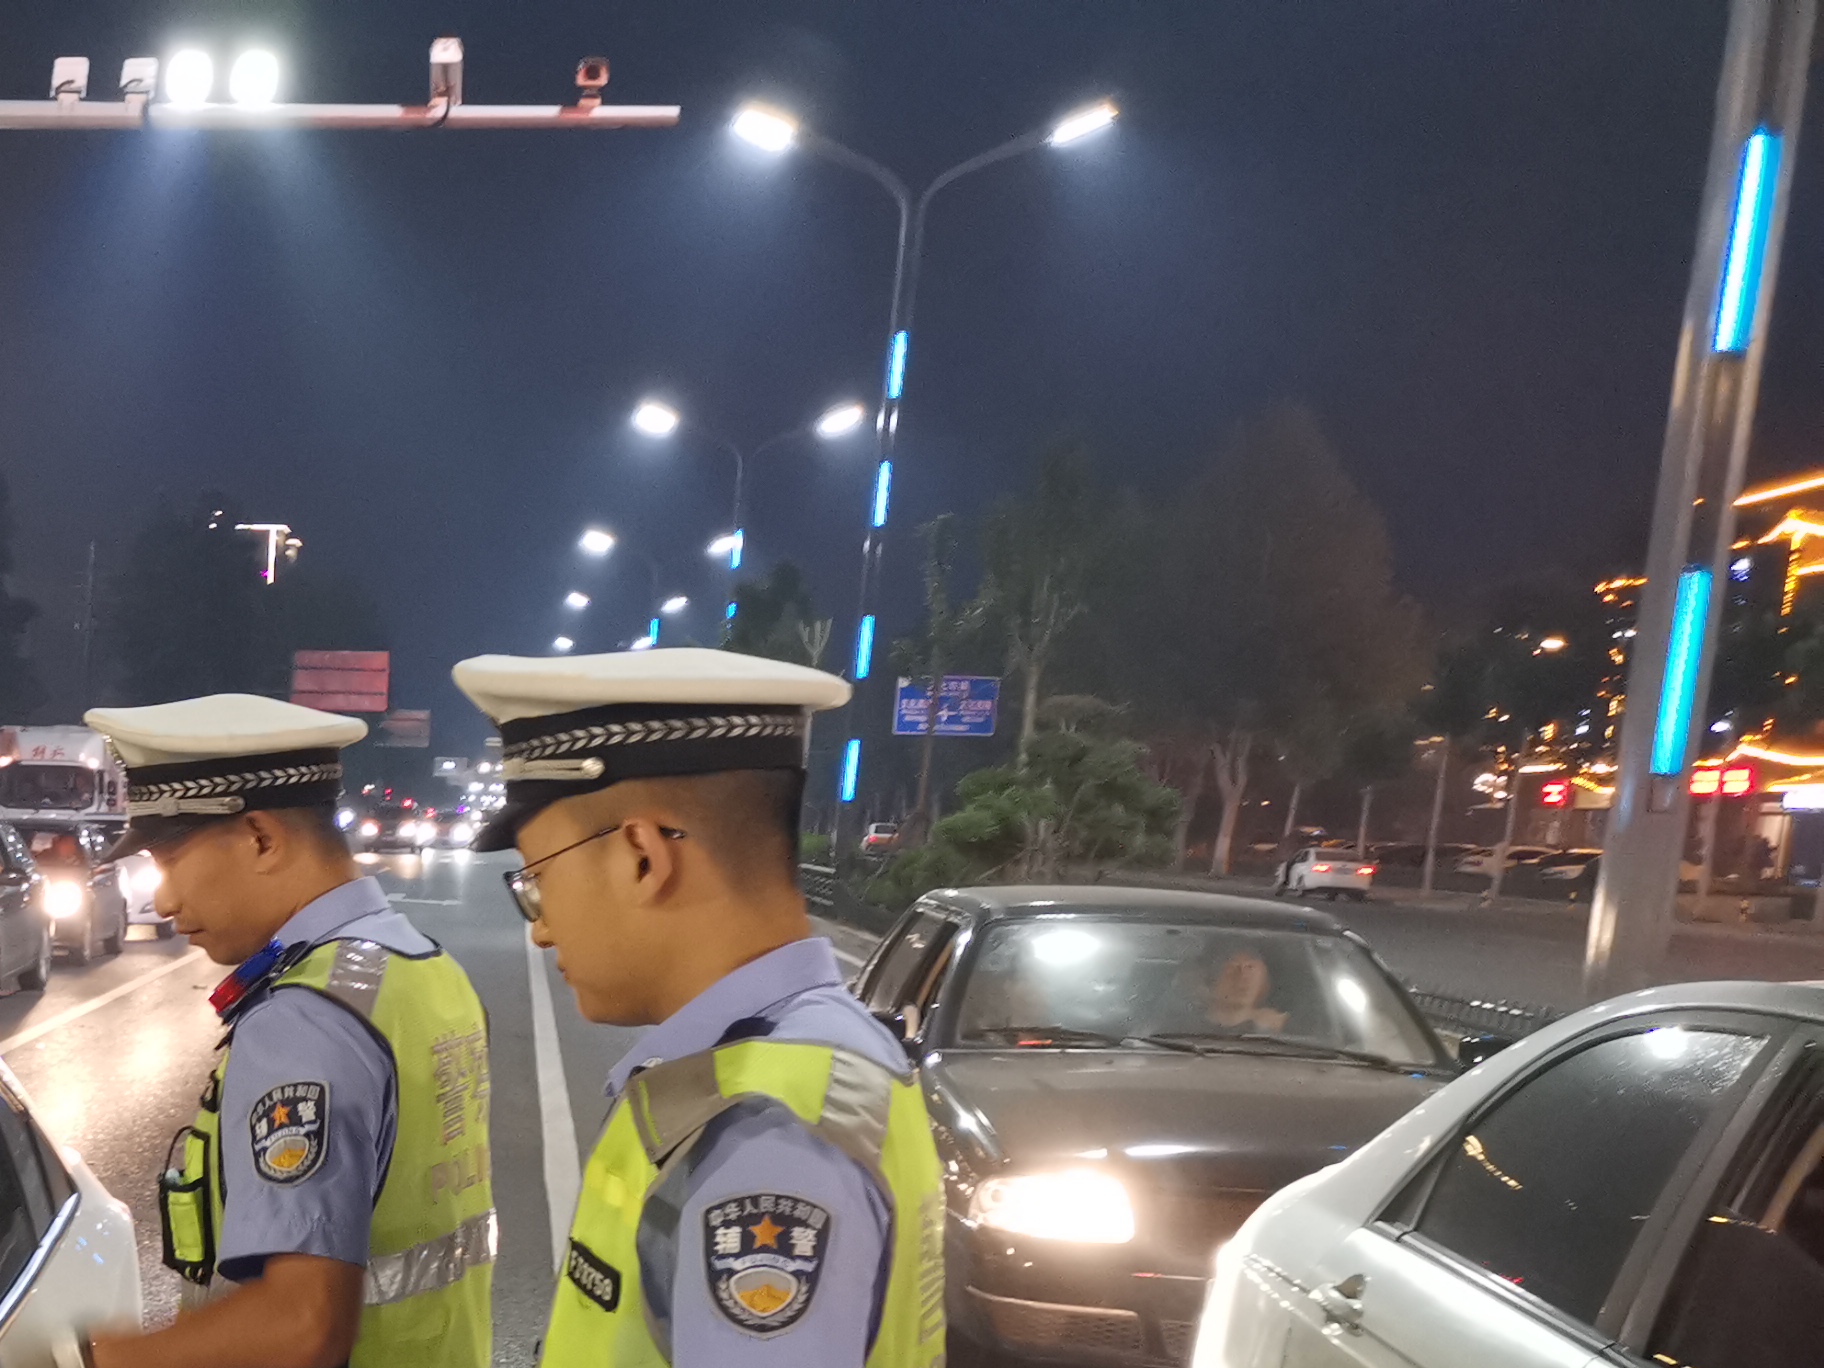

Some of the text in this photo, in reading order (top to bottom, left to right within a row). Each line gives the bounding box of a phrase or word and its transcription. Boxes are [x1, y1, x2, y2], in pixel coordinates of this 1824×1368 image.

[708, 1195, 828, 1229] 中华人民共和国
[787, 1226, 818, 1256] 警
